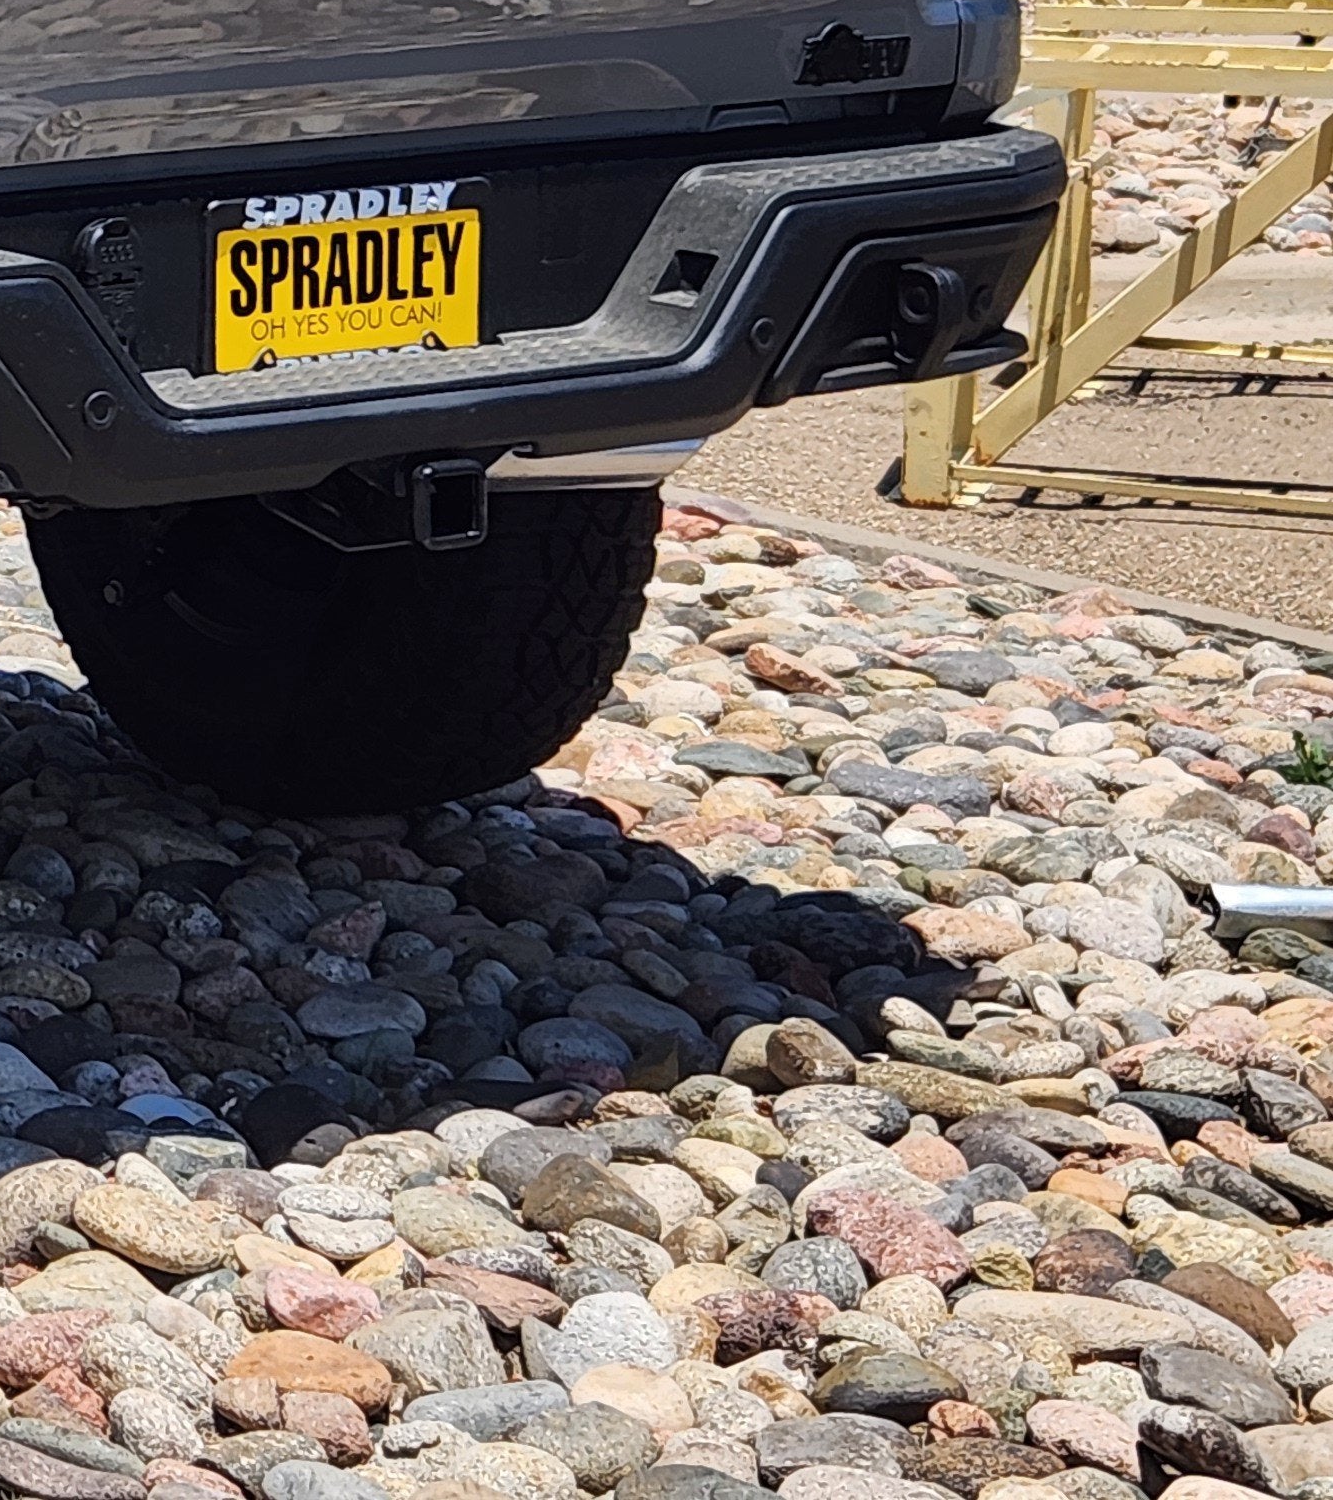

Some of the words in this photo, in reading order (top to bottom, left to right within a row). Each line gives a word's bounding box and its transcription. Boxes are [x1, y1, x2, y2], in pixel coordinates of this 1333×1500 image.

[242, 181, 457, 231] SPRADLEY
[230, 222, 466, 317] SPRADLEY
[251, 317, 285, 341] OH
[294, 313, 329, 337] YES
[336, 307, 383, 332] YOU
[390, 302, 442, 327] CAN!
